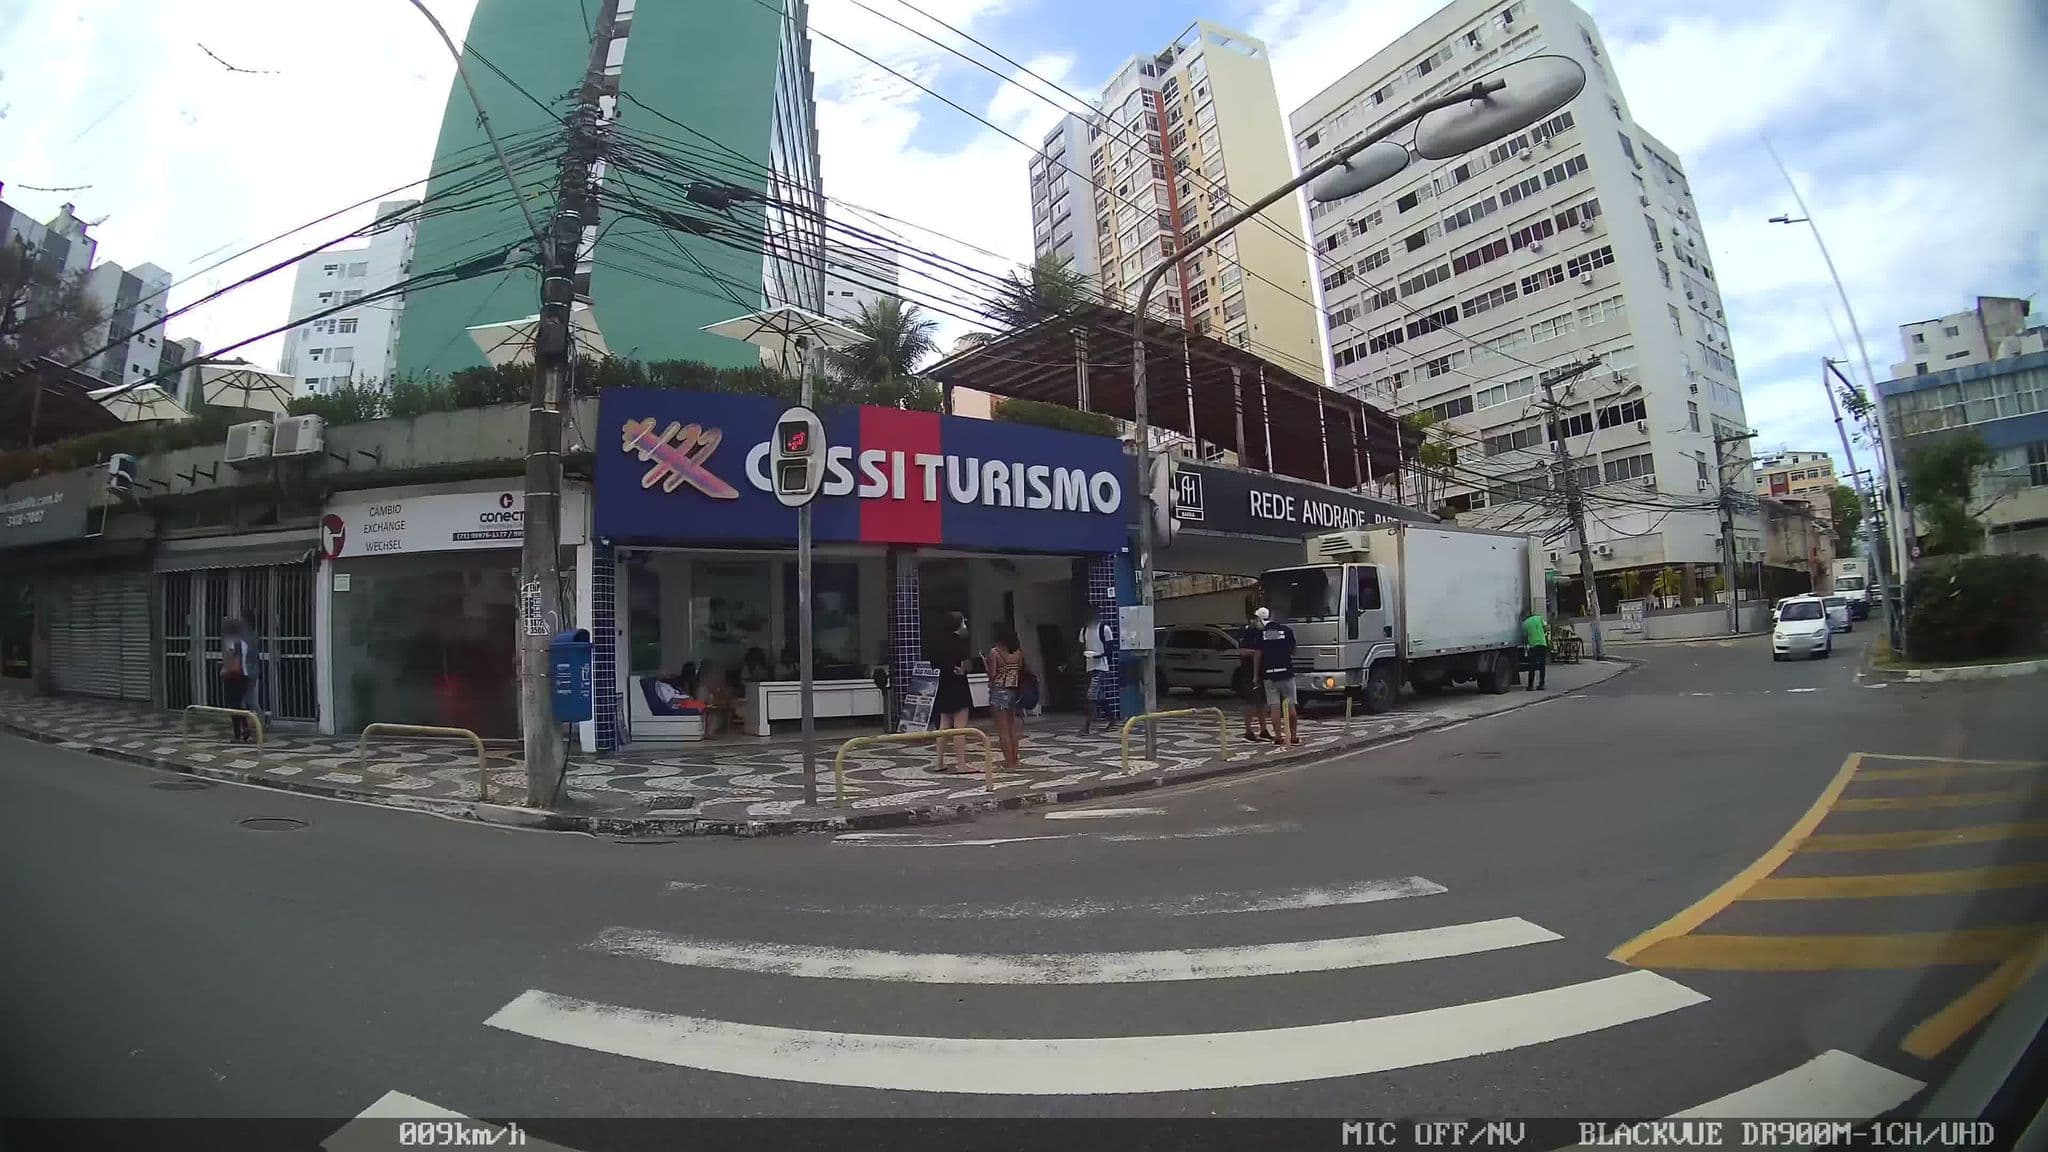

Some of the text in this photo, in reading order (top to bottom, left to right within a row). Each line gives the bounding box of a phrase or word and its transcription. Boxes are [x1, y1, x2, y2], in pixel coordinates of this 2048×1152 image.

[745, 441, 1122, 515] CSSI TURISMO
[1250, 490, 1365, 529] REDE ANDRADE
[363, 520, 406, 534] EXCHANGE
[366, 539, 402, 552] WECHSEL
